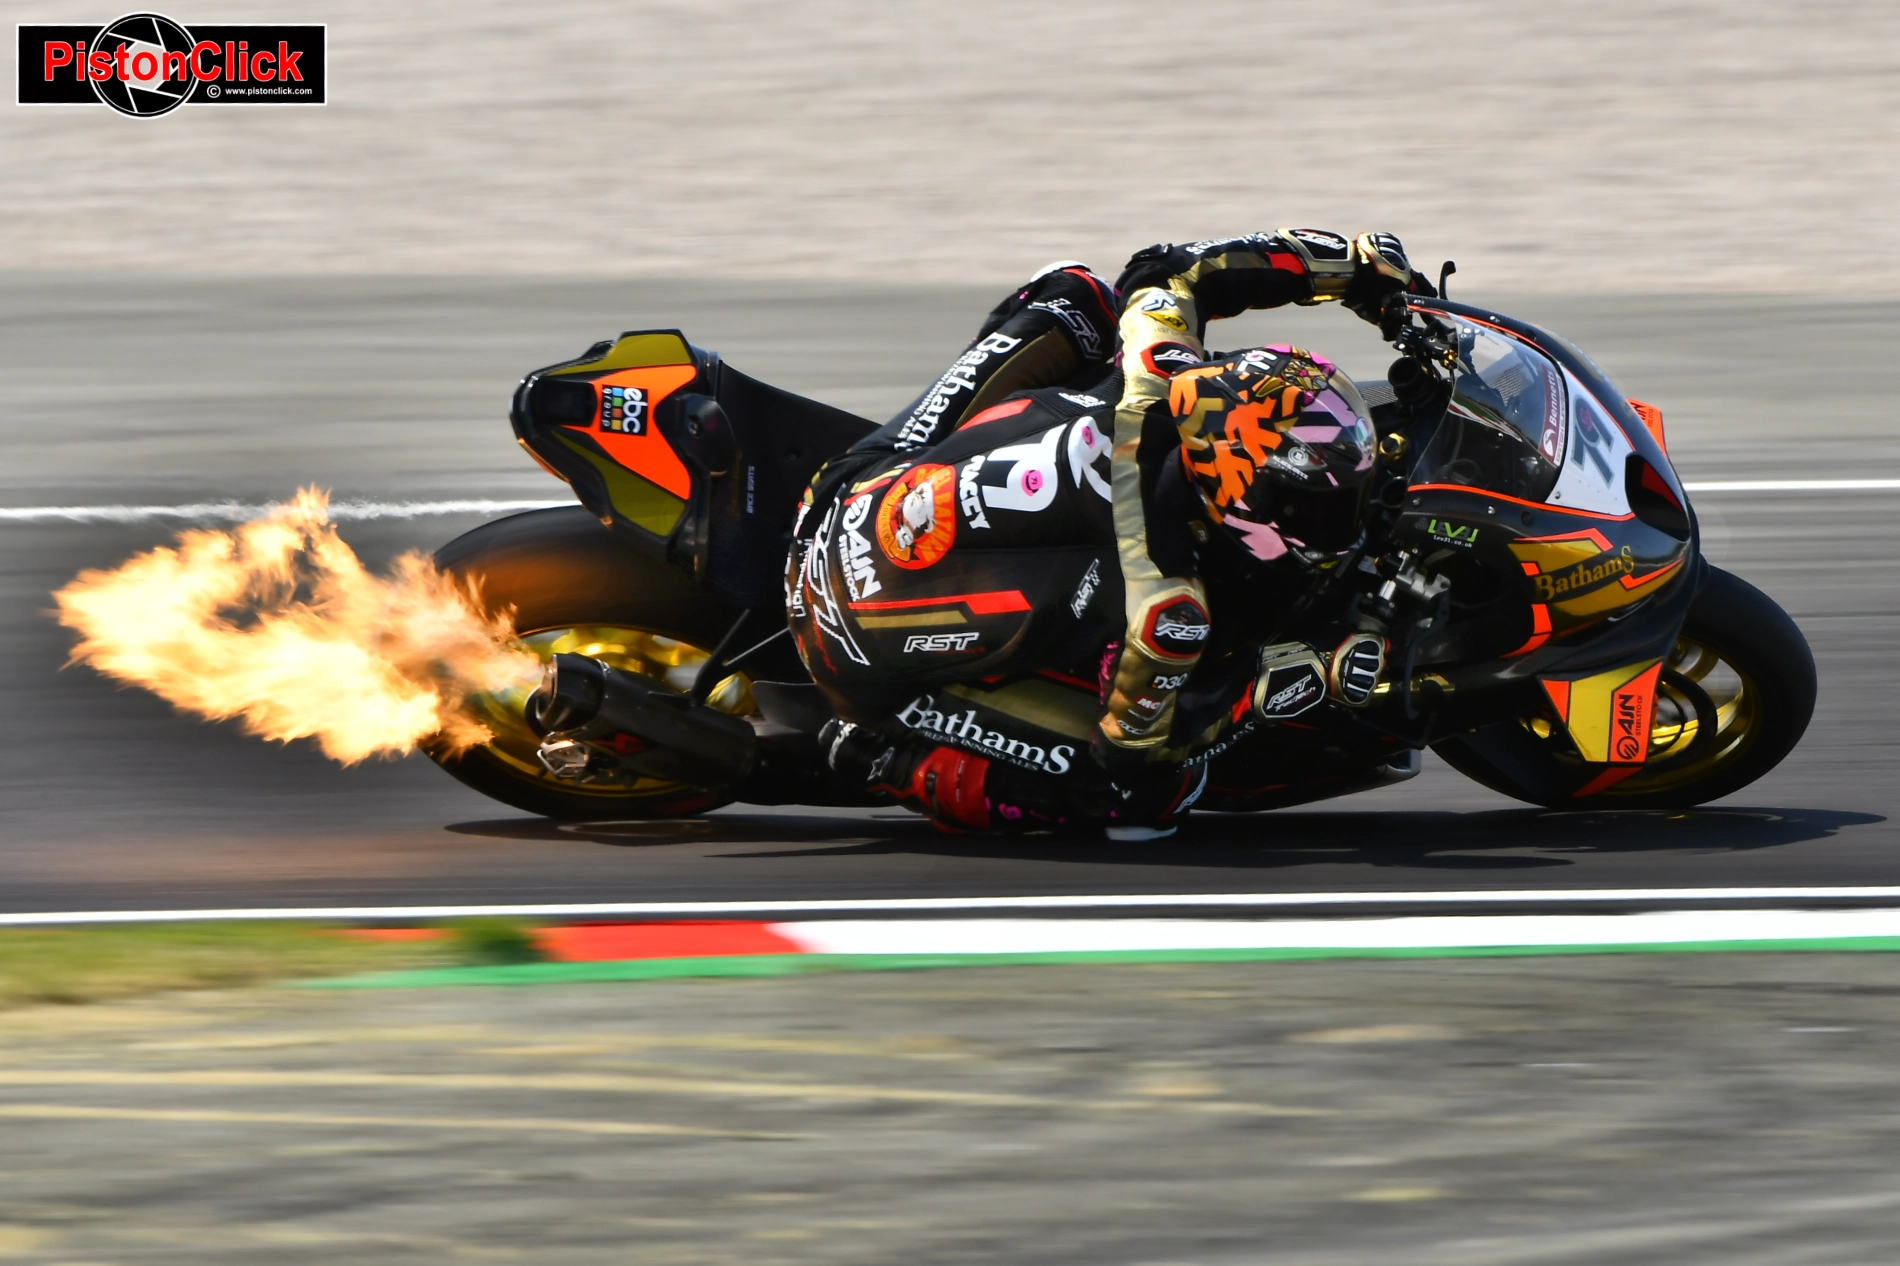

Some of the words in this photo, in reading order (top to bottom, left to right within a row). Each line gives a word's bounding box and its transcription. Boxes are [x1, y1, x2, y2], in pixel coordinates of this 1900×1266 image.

[622, 387, 648, 434] ebc
[839, 534, 861, 602] STEELSTOCK
[903, 632, 979, 653] RST
[1155, 622, 1211, 642] RST
[1266, 674, 1312, 710] RST
[1618, 694, 1635, 735] AJN
[1006, 756, 1039, 773] ALES
